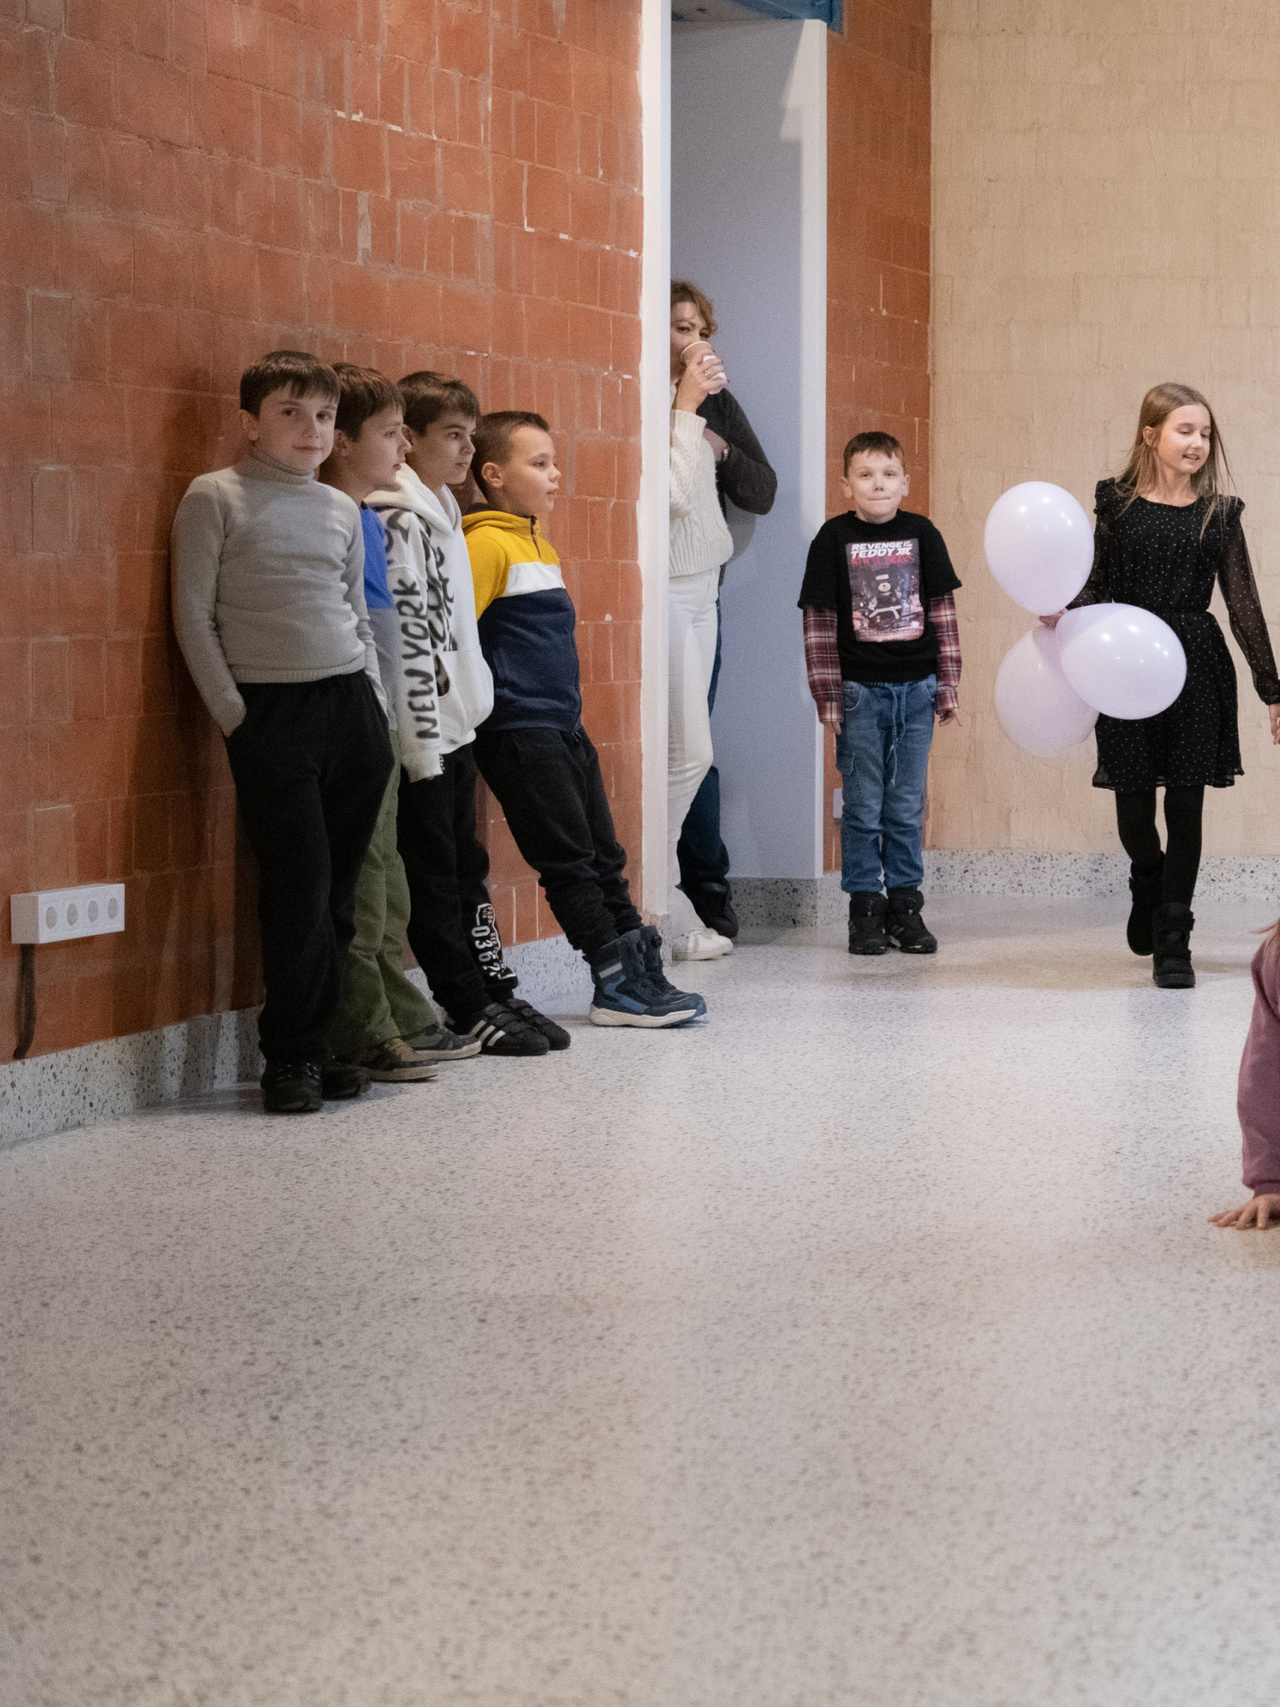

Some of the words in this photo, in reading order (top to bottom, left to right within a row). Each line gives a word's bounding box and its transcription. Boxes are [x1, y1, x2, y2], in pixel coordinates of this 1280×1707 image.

[851, 541, 903, 551] REVENGE
[851, 548, 895, 559] TEDDY
[393, 578, 431, 661] YORK
[404, 668, 440, 740] NEW
